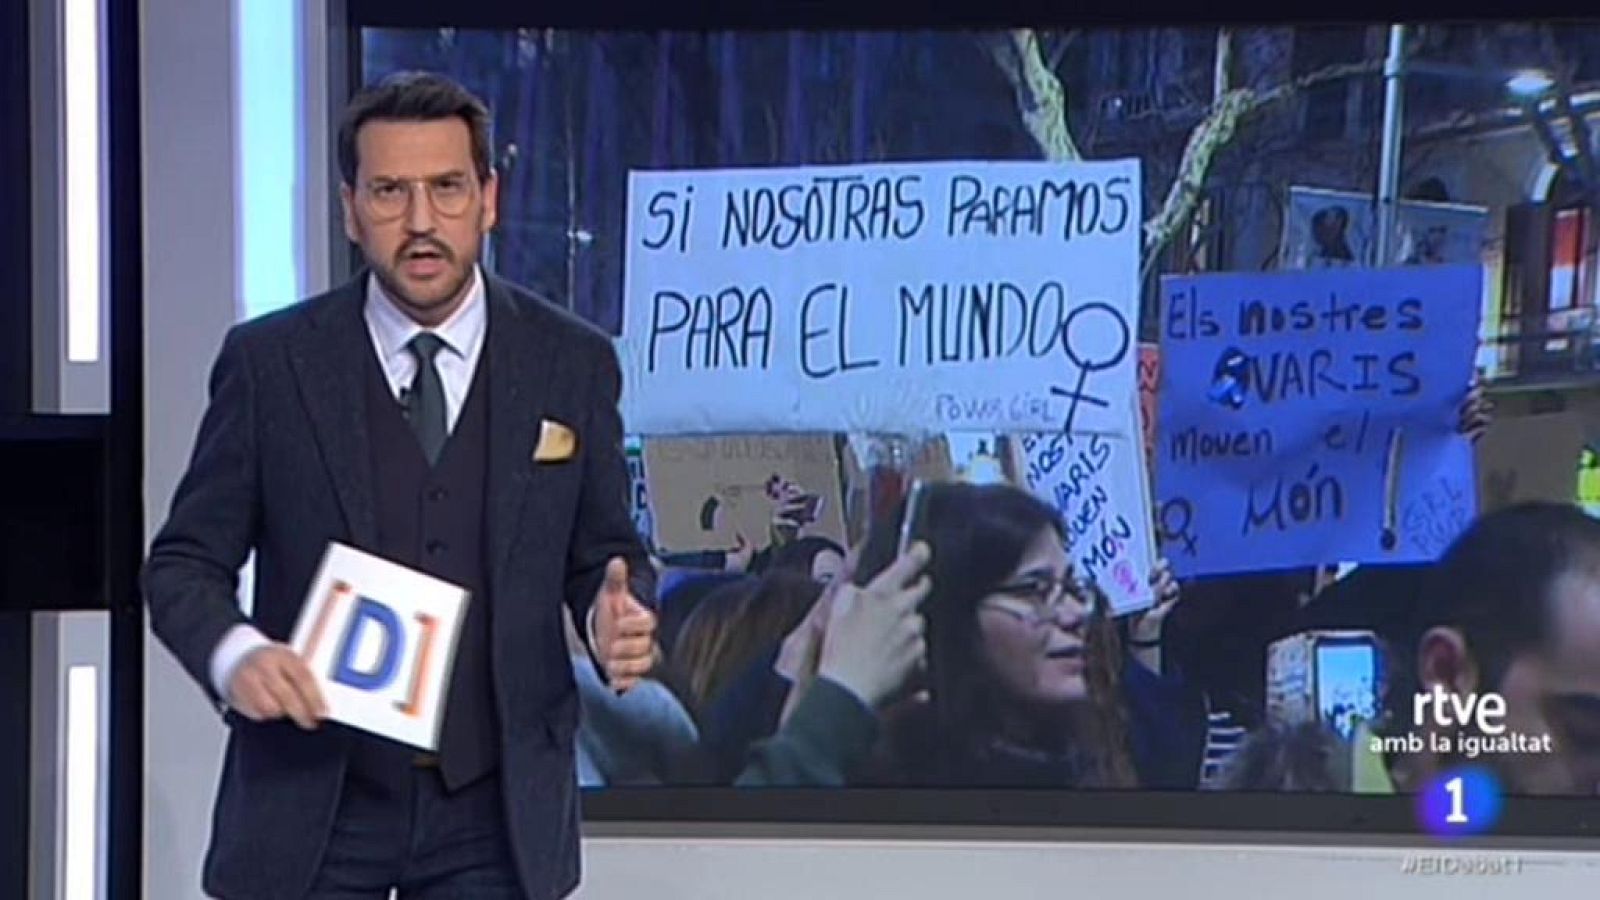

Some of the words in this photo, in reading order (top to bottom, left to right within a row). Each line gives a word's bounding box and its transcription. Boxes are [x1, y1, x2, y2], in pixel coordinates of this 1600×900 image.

[722, 175, 924, 249] NOSOTRAS
[948, 175, 1131, 241] PARAMOS
[648, 285, 773, 372] PARA
[800, 284, 879, 378] EL
[900, 281, 1065, 366] MUNDO
[1167, 286, 1220, 339] Els
[1238, 293, 1424, 335] nostres
[1323, 411, 1369, 455] el
